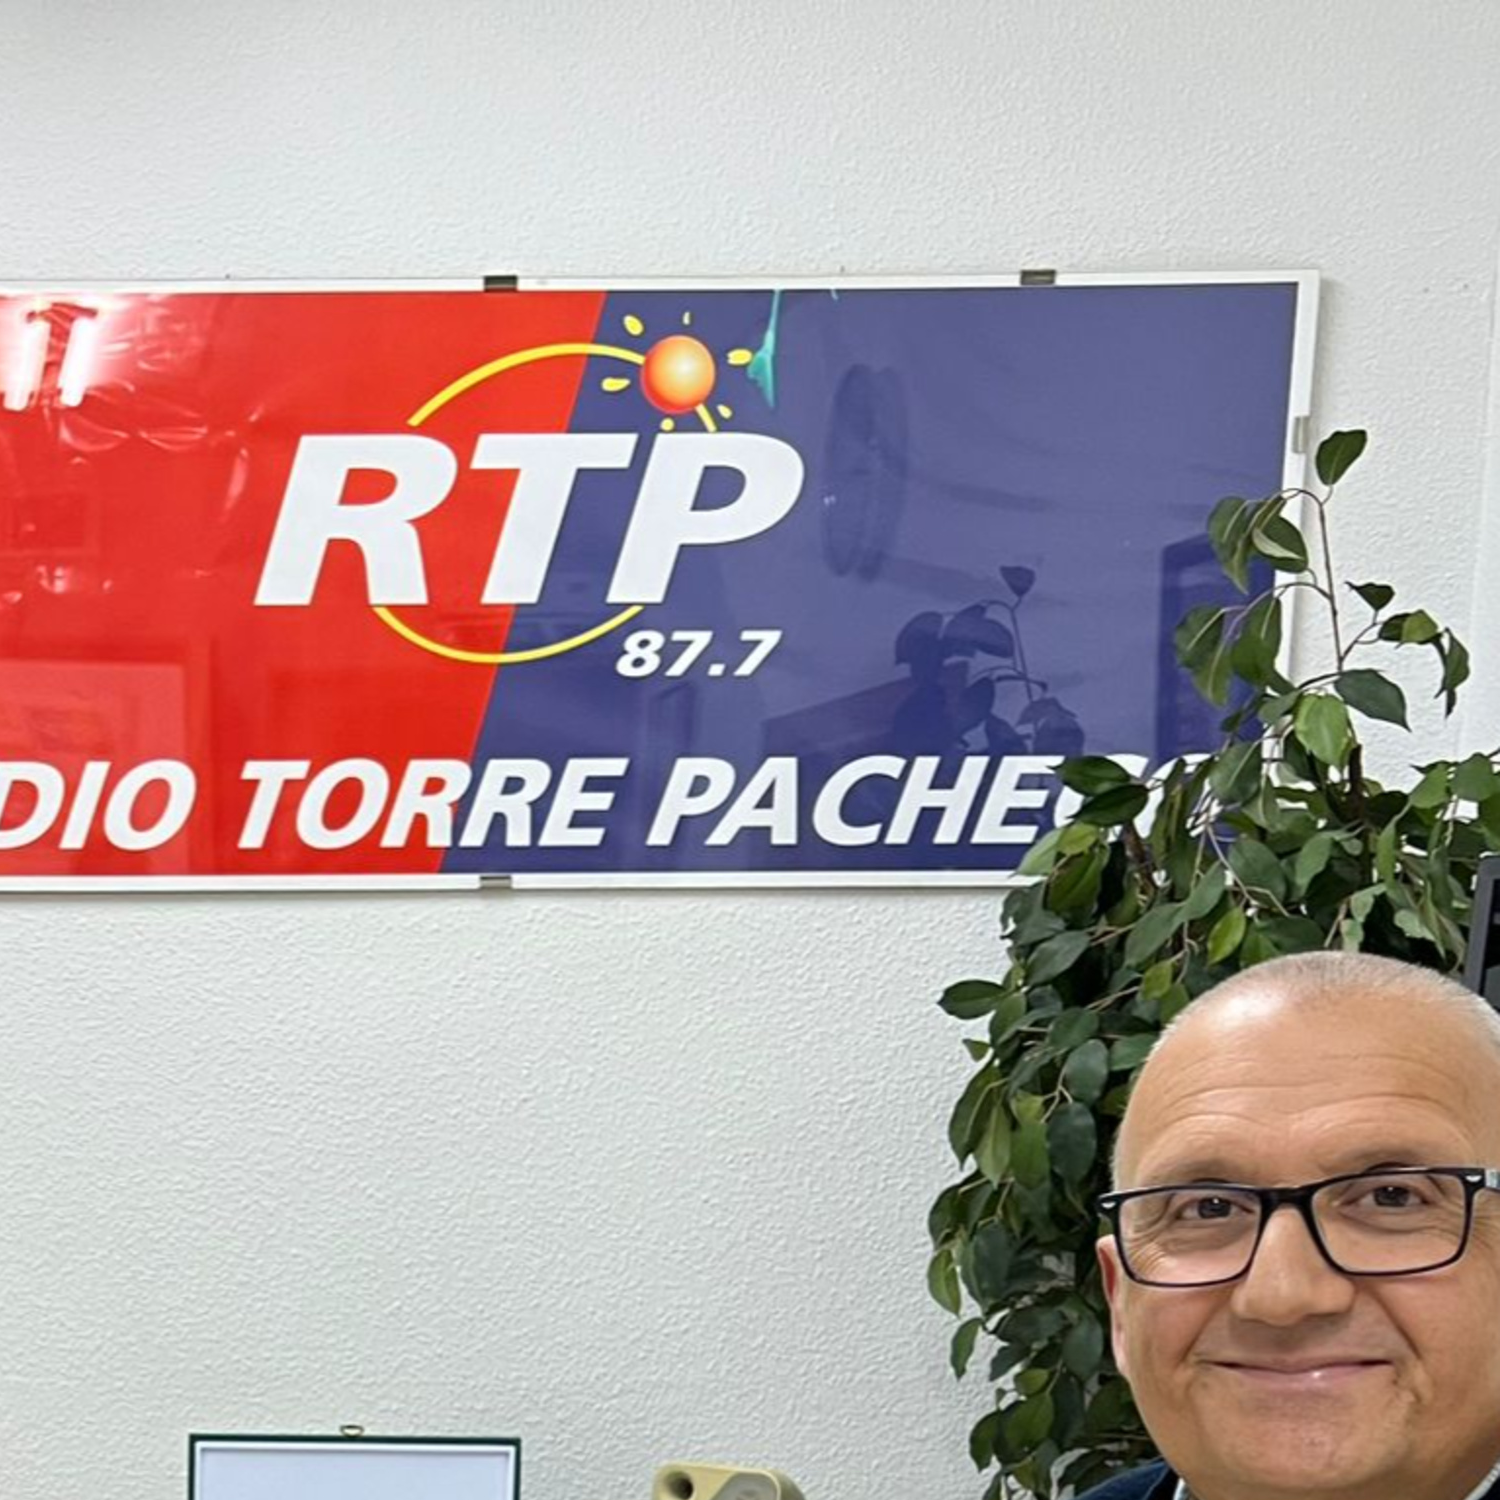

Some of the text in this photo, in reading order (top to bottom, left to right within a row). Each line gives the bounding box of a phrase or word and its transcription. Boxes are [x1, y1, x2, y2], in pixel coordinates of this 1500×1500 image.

[254, 432, 805, 607] RTP
[614, 628, 782, 679] 87.7
[237, 755, 630, 850] TORRE
